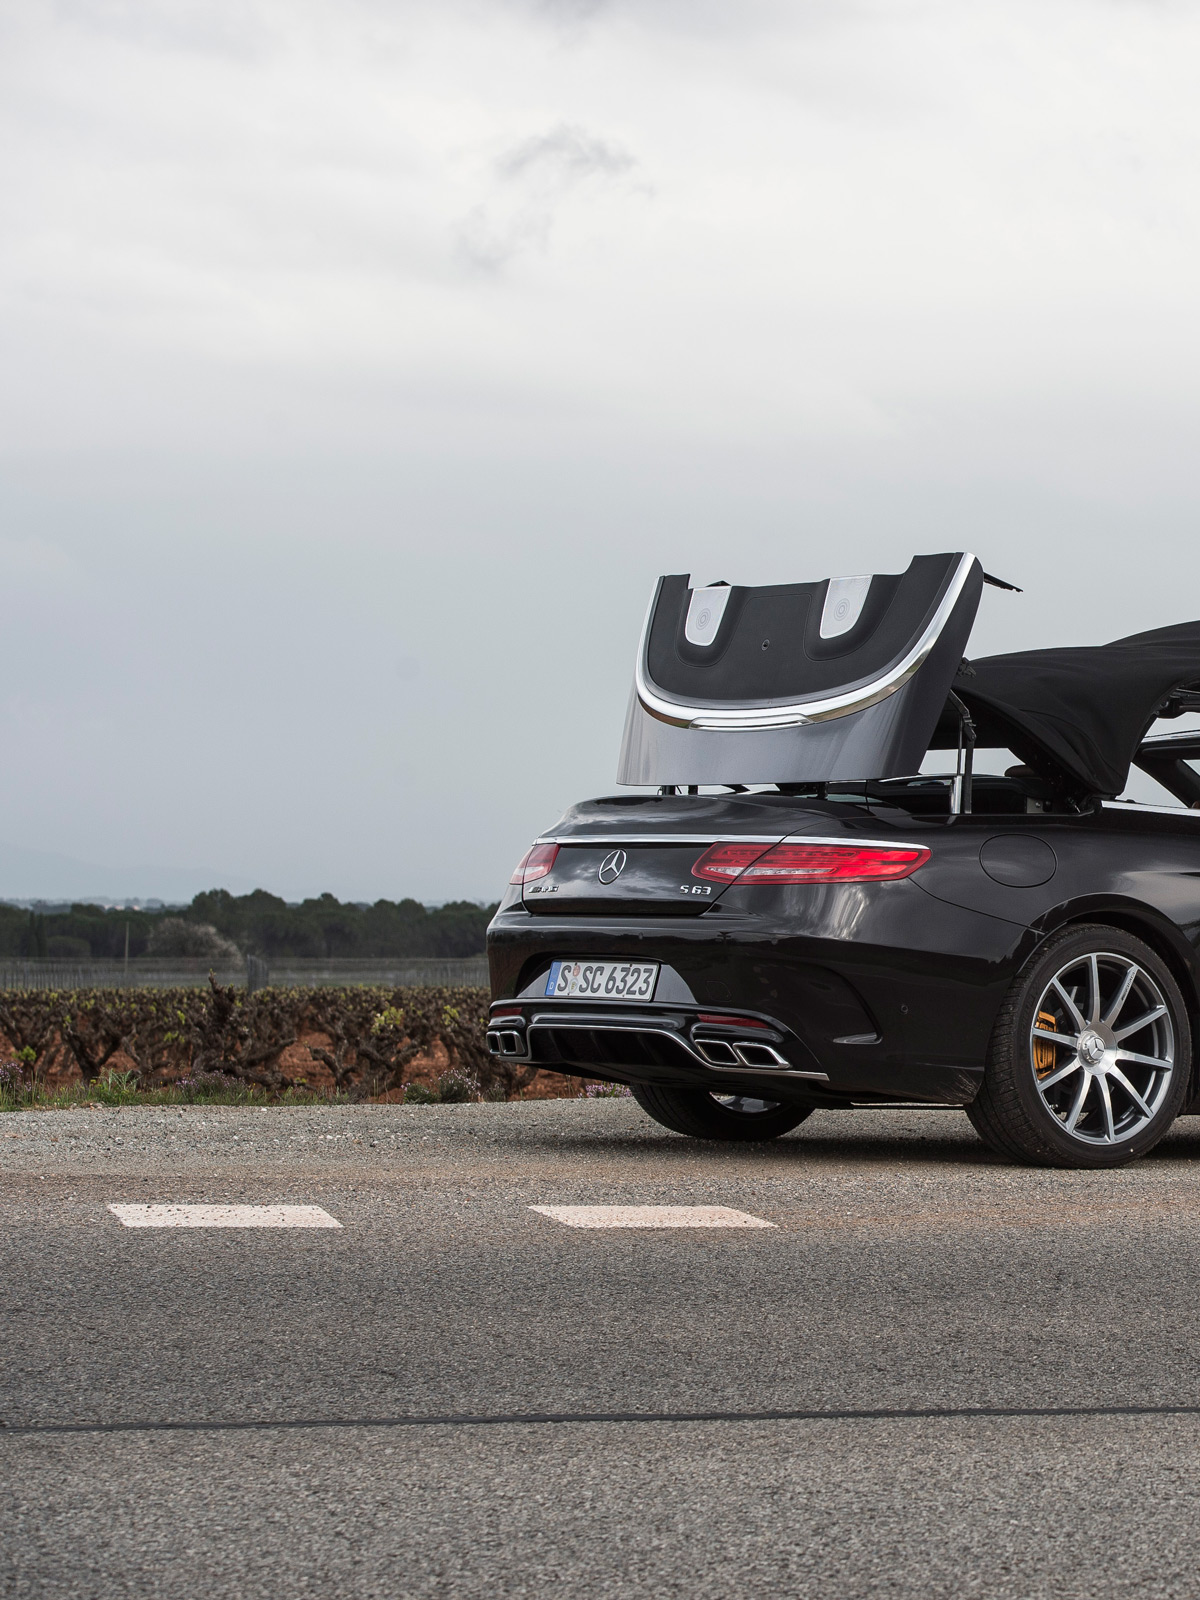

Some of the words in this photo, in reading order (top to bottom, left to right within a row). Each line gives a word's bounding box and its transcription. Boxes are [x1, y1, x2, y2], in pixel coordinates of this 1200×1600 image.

[680, 885, 689, 894] S
[691, 886, 711, 895] 63
[557, 965, 572, 992] S
[579, 965, 604, 993] SC
[605, 966, 653, 996] 6323
